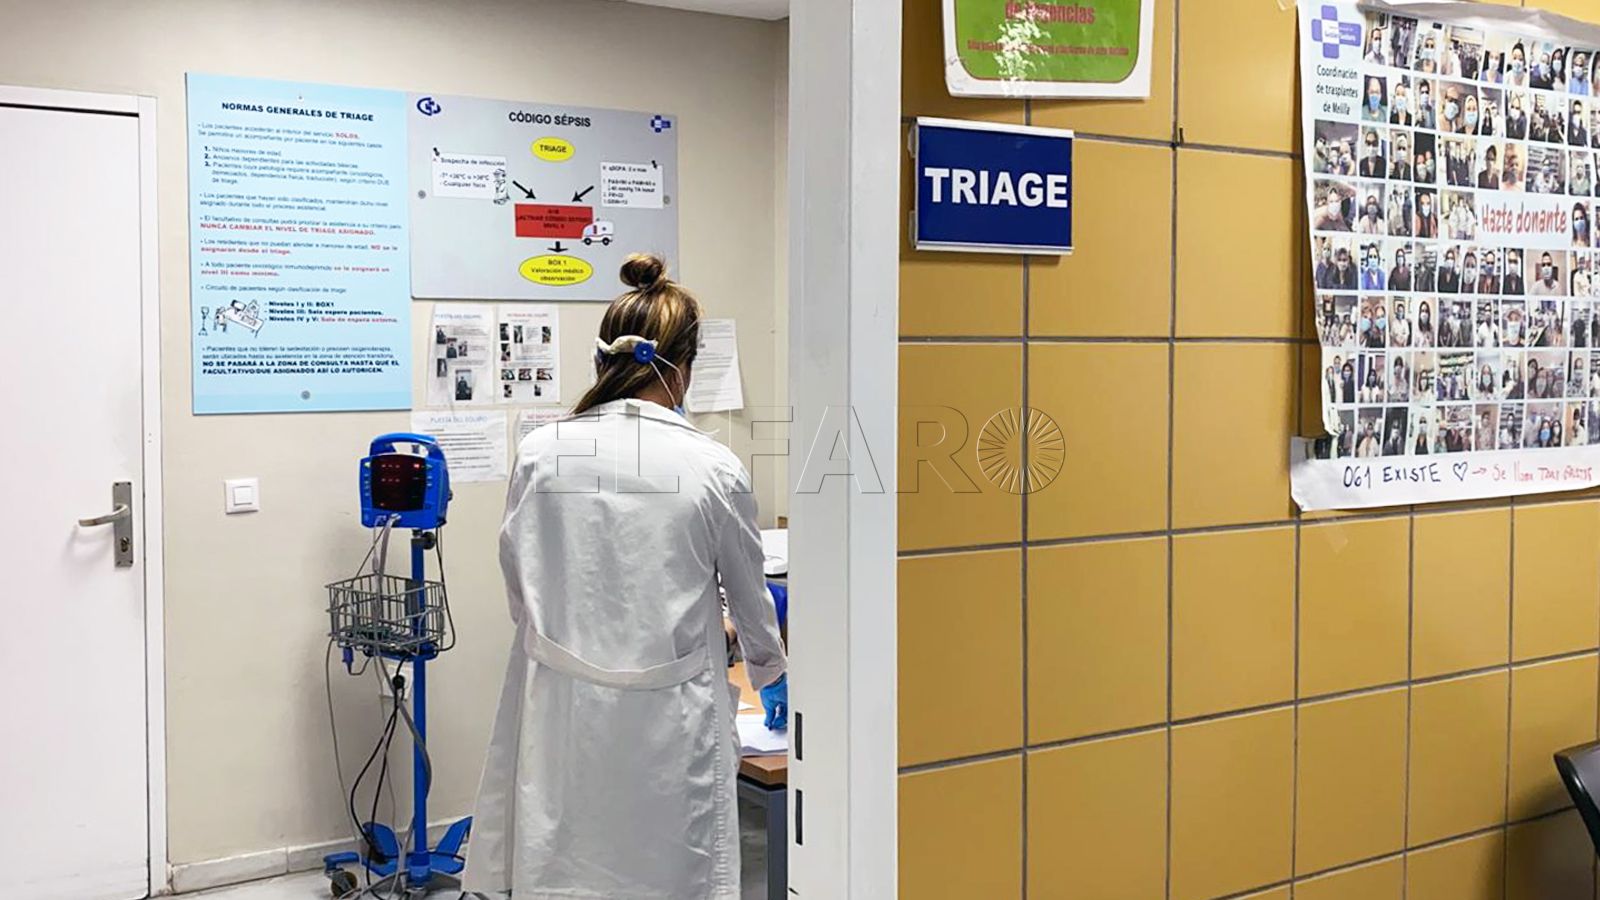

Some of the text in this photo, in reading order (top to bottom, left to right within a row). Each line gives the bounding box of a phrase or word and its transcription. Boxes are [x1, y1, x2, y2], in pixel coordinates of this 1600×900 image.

[1317, 64, 1358, 79] Coordinación
[1316, 82, 1358, 98] de trasplantes
[222, 102, 263, 112] NORMAS
[266, 106, 322, 117] GENERALES
[340, 112, 374, 121] TRIAGE
[1323, 102, 1331, 113] de
[508, 110, 591, 127] CÓDIGO SÉPSIS
[540, 144, 567, 153] TRIAGE
[924, 167, 1068, 208] TRIAGE
[1482, 201, 1566, 233] Hazte donante
[1343, 465, 1371, 488] 061
[1383, 463, 1441, 483] EXISTE
